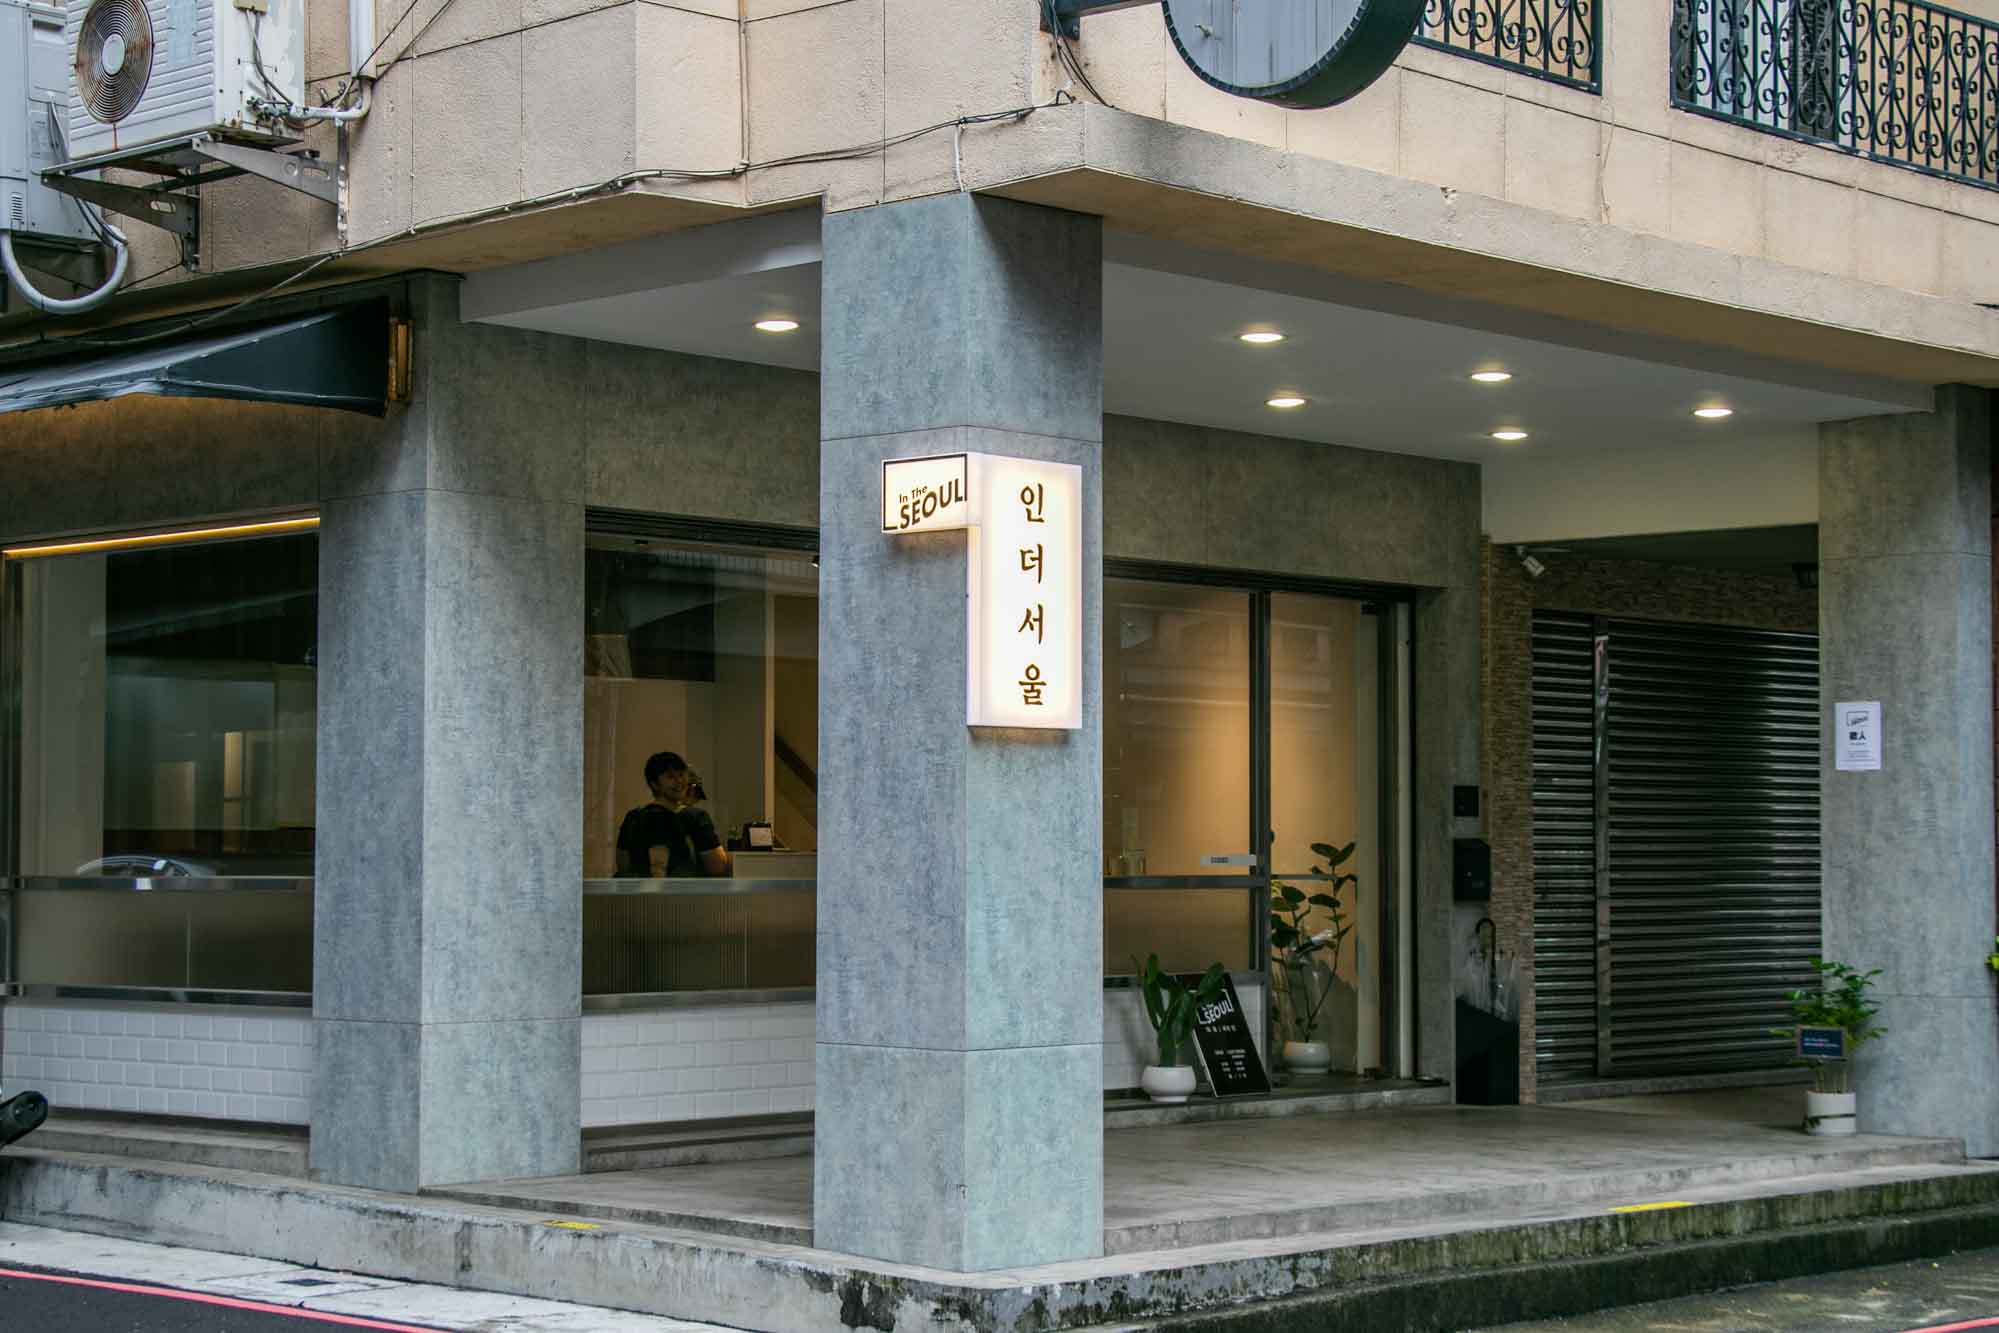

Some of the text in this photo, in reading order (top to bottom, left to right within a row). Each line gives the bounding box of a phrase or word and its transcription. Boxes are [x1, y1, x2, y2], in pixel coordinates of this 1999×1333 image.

[899, 485, 928, 504] In The
[900, 478, 963, 529] SEOUL
[1018, 483, 1047, 706] 인더서울
[1204, 1000, 1233, 1024] SEOUL
